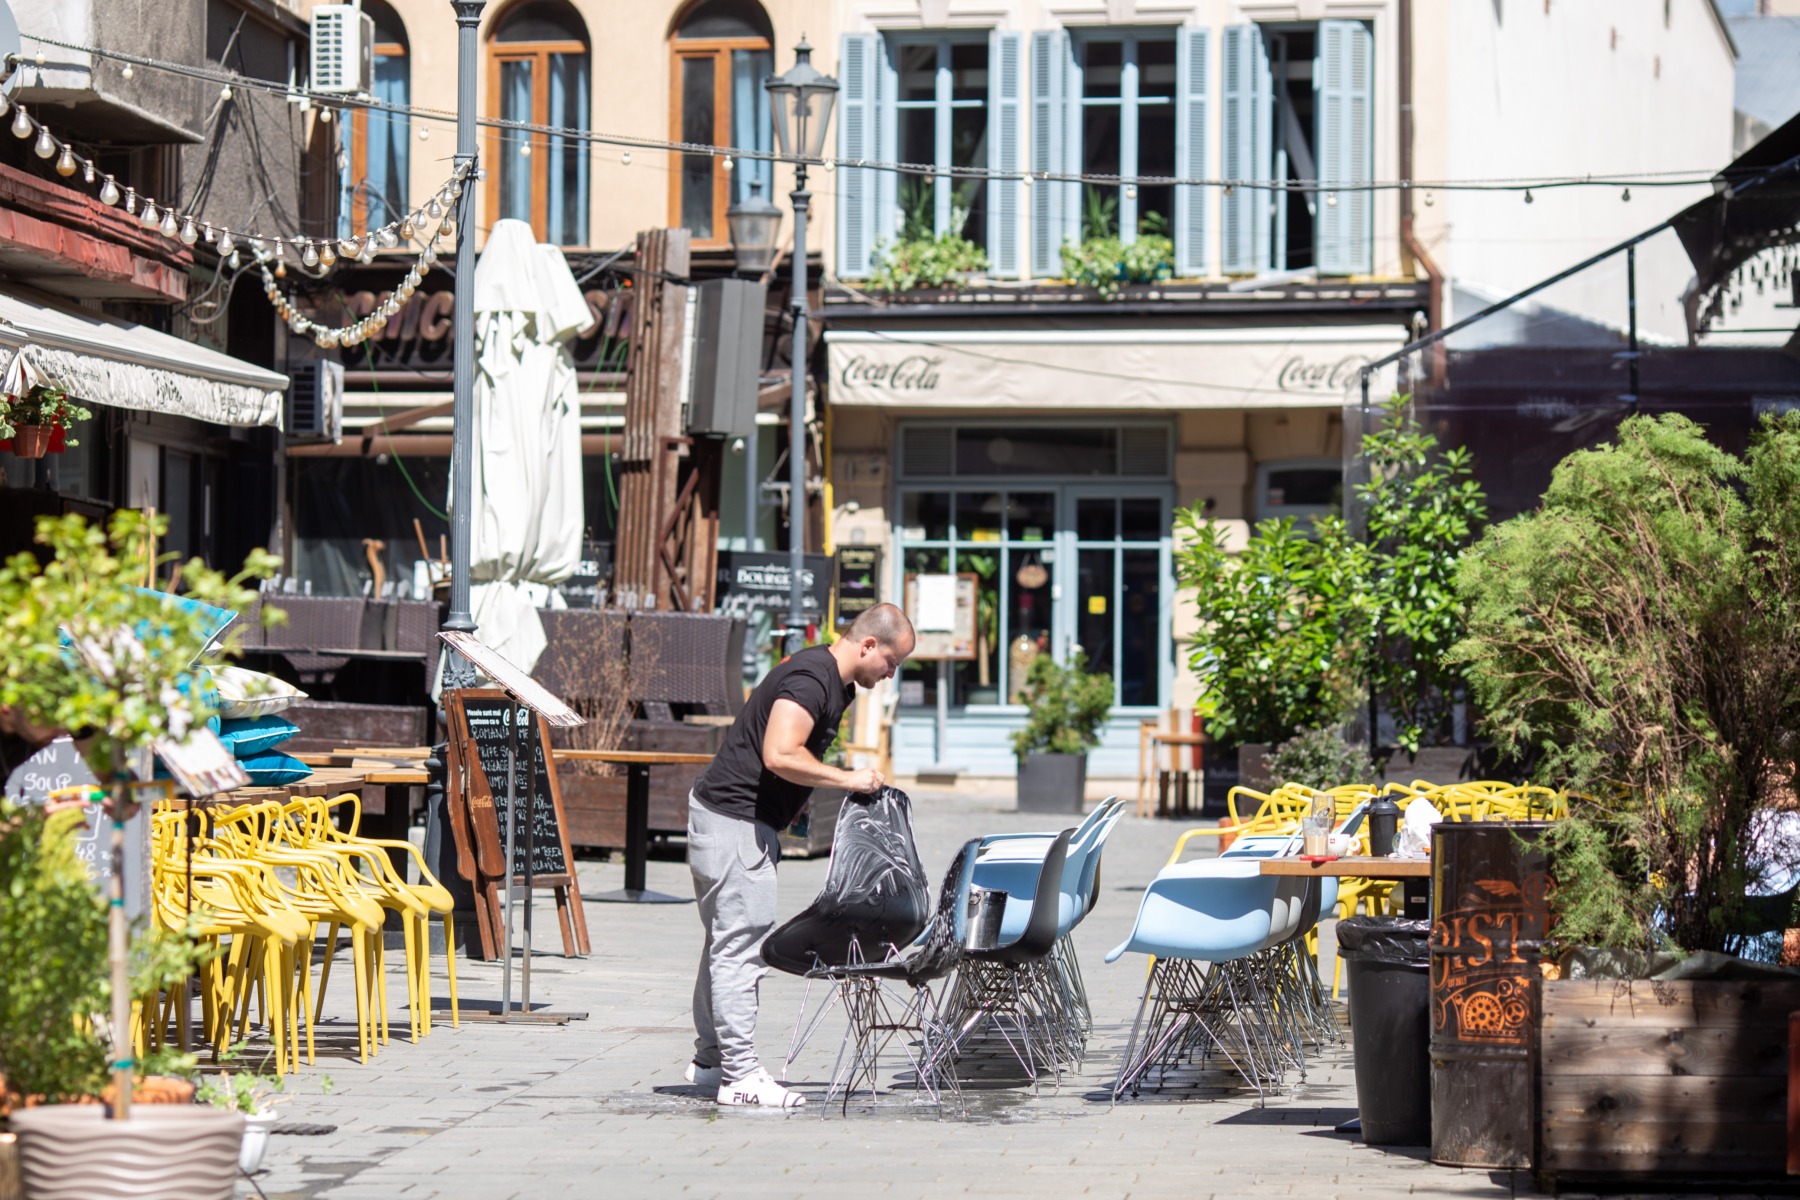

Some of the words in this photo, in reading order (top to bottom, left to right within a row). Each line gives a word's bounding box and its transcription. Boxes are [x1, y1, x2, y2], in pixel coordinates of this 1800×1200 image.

[1278, 354, 1381, 391] Coca-Co
[471, 725, 511, 740] ROMANIA
[733, 1092, 760, 1104] FILA
